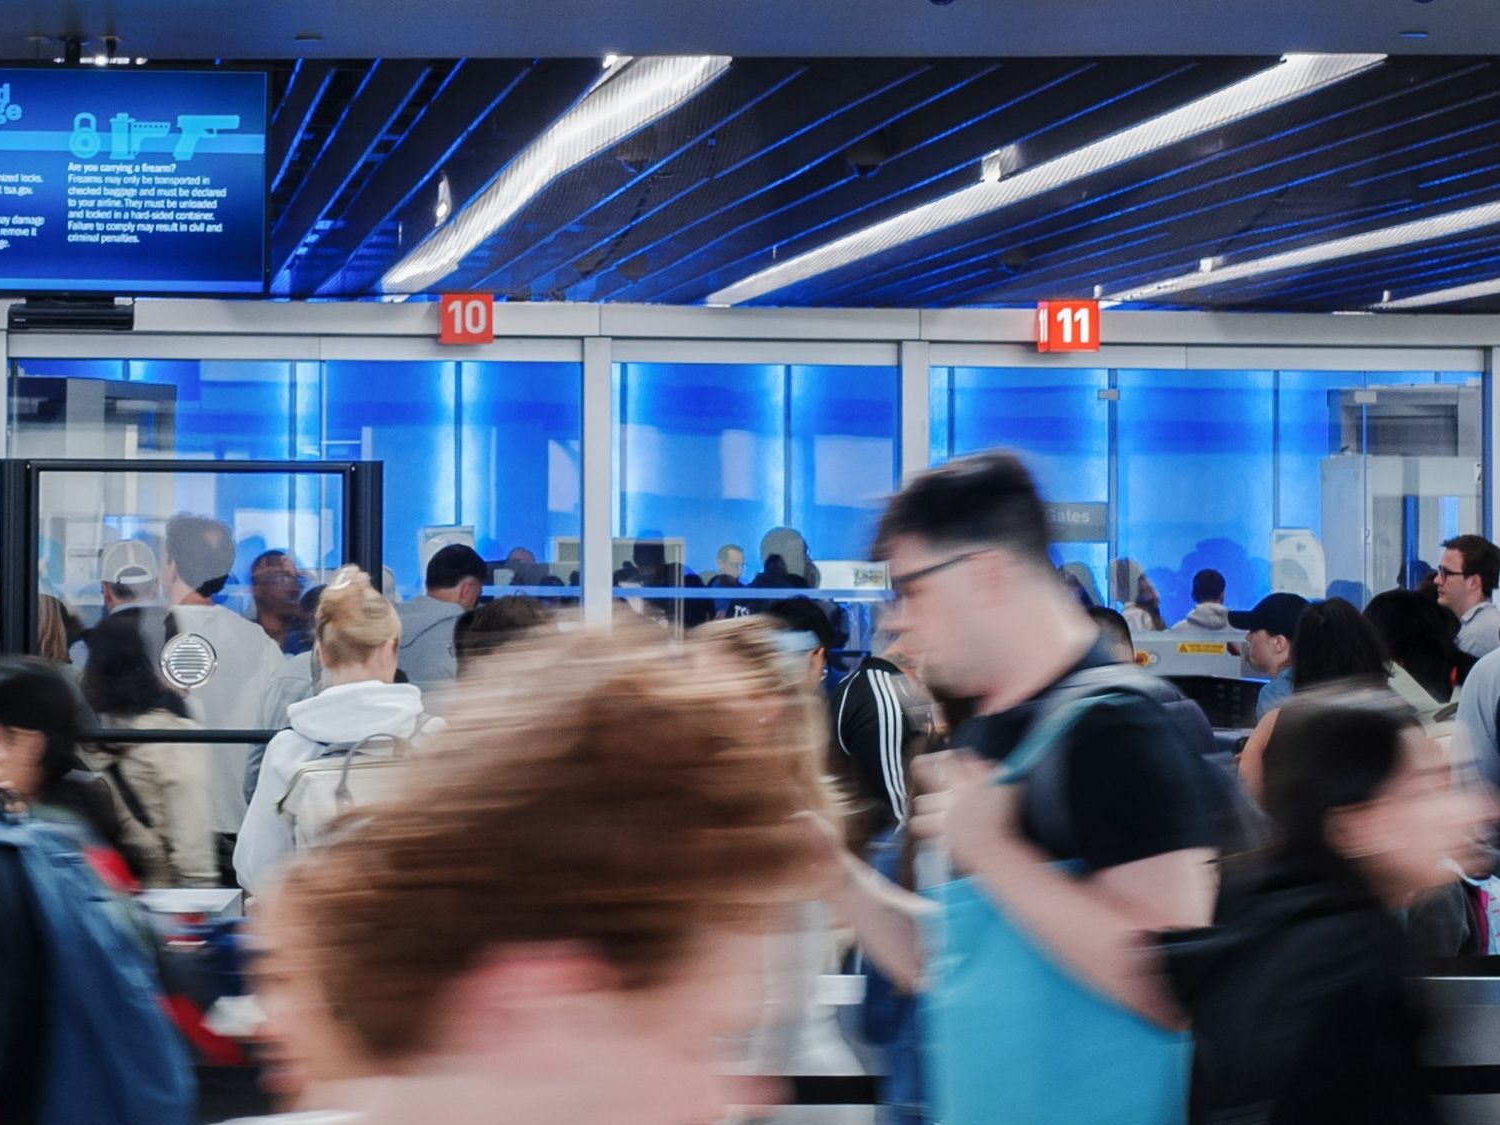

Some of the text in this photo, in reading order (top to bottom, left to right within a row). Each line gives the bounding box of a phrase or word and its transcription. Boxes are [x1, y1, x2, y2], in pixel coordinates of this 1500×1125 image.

[68, 162, 177, 174] Are you carrying a firearm?
[104, 176, 122, 185] may
[123, 175, 140, 185] only
[141, 175, 153, 184] be
[154, 175, 201, 186] transported
[202, 176, 210, 185] in
[67, 186, 227, 198] checked baggage and must be declared
[67, 198, 77, 207] to
[78, 200, 95, 209] your
[125, 199, 143, 210] They
[144, 200, 165, 208] must
[166, 199, 177, 208] be
[179, 199, 217, 209] unloaded
[67, 209, 215, 220] and locked in a hard-sided container.
[12, 215, 45, 227] damage
[68, 221, 223, 233] Failure to comply may result in civil and
[0, 228, 29, 236] remove
[31, 227, 37, 236] it
[67, 233, 100, 243] criminal
[447, 299, 487, 335] 10
[1057, 307, 1090, 343] 11
